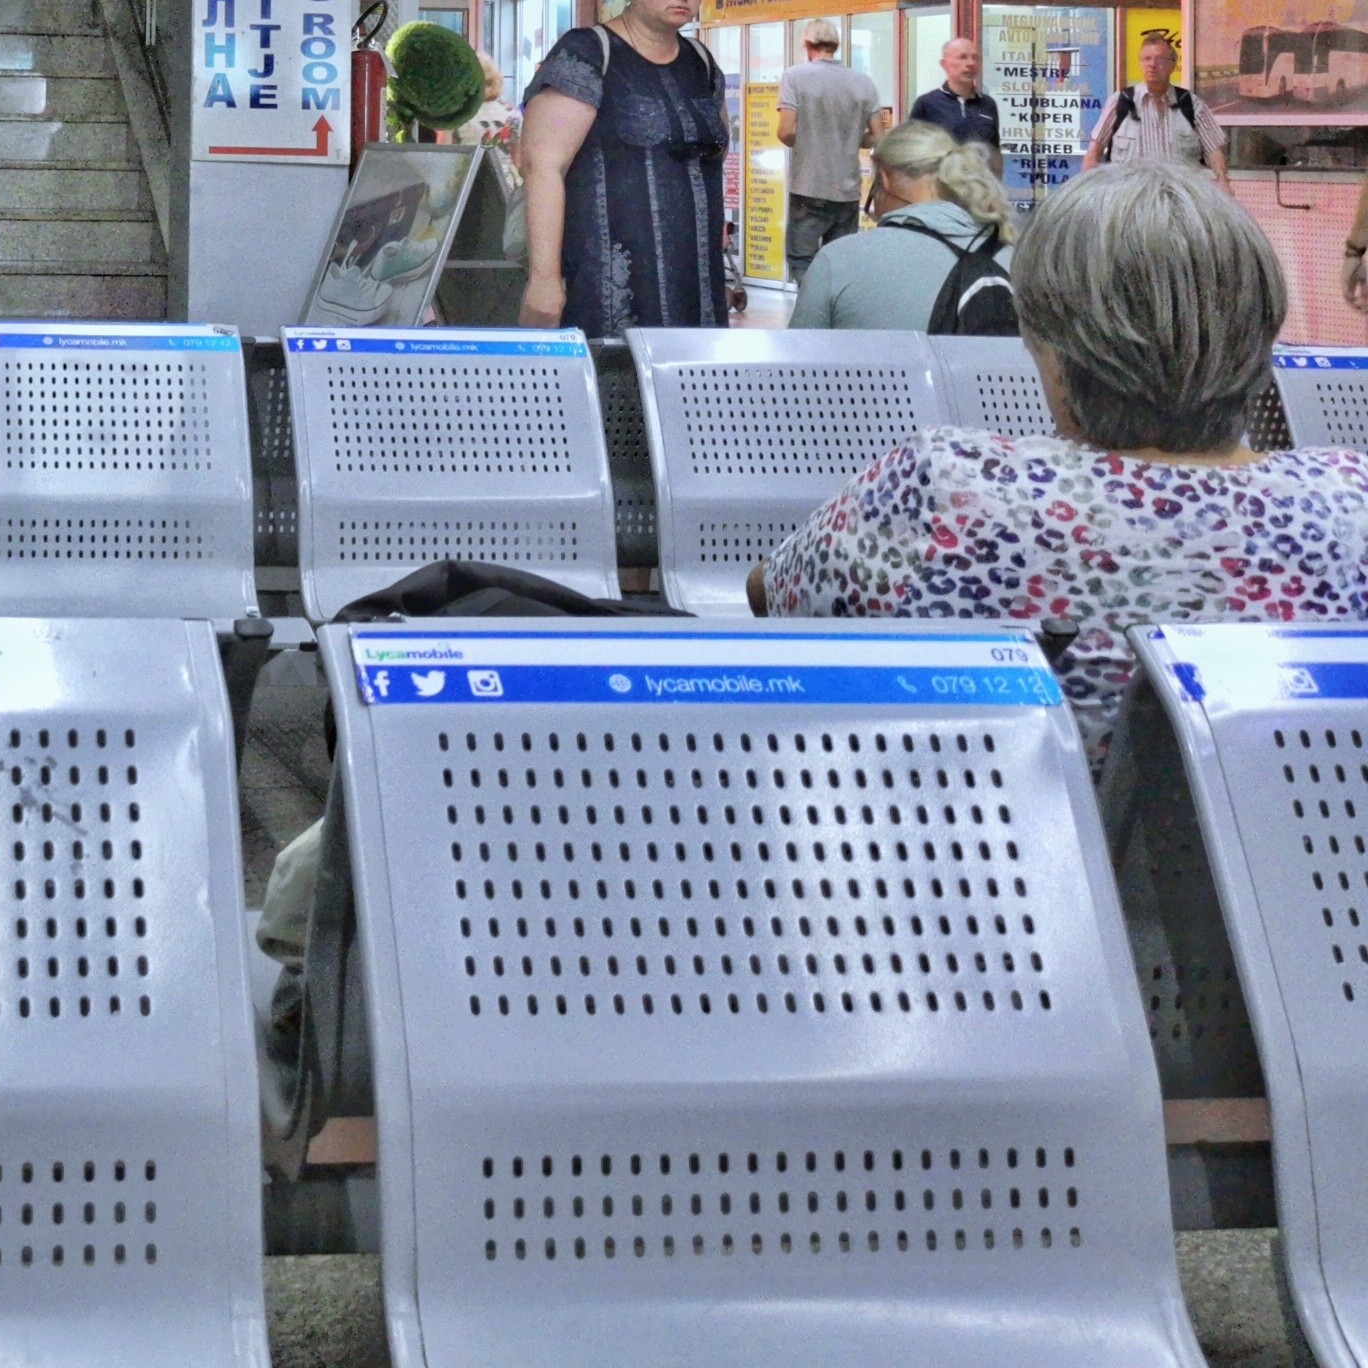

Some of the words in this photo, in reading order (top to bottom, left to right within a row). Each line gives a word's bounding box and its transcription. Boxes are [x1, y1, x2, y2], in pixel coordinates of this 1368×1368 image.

[300, 13, 340, 111] ROOM
[1004, 66, 1070, 78] MESTRE
[1010, 97, 1102, 109] LJUBLJANA
[1018, 112, 1073, 123] KOPER
[1001, 127, 1086, 139] HRVTSKA
[1010, 143, 1073, 154] ZAGREB
[365, 645, 464, 661] Lycamobile
[991, 647, 1029, 662] 079
[645, 674, 805, 697] lycamobile.mk
[931, 676, 976, 694] 079
[985, 677, 1008, 694] 12
